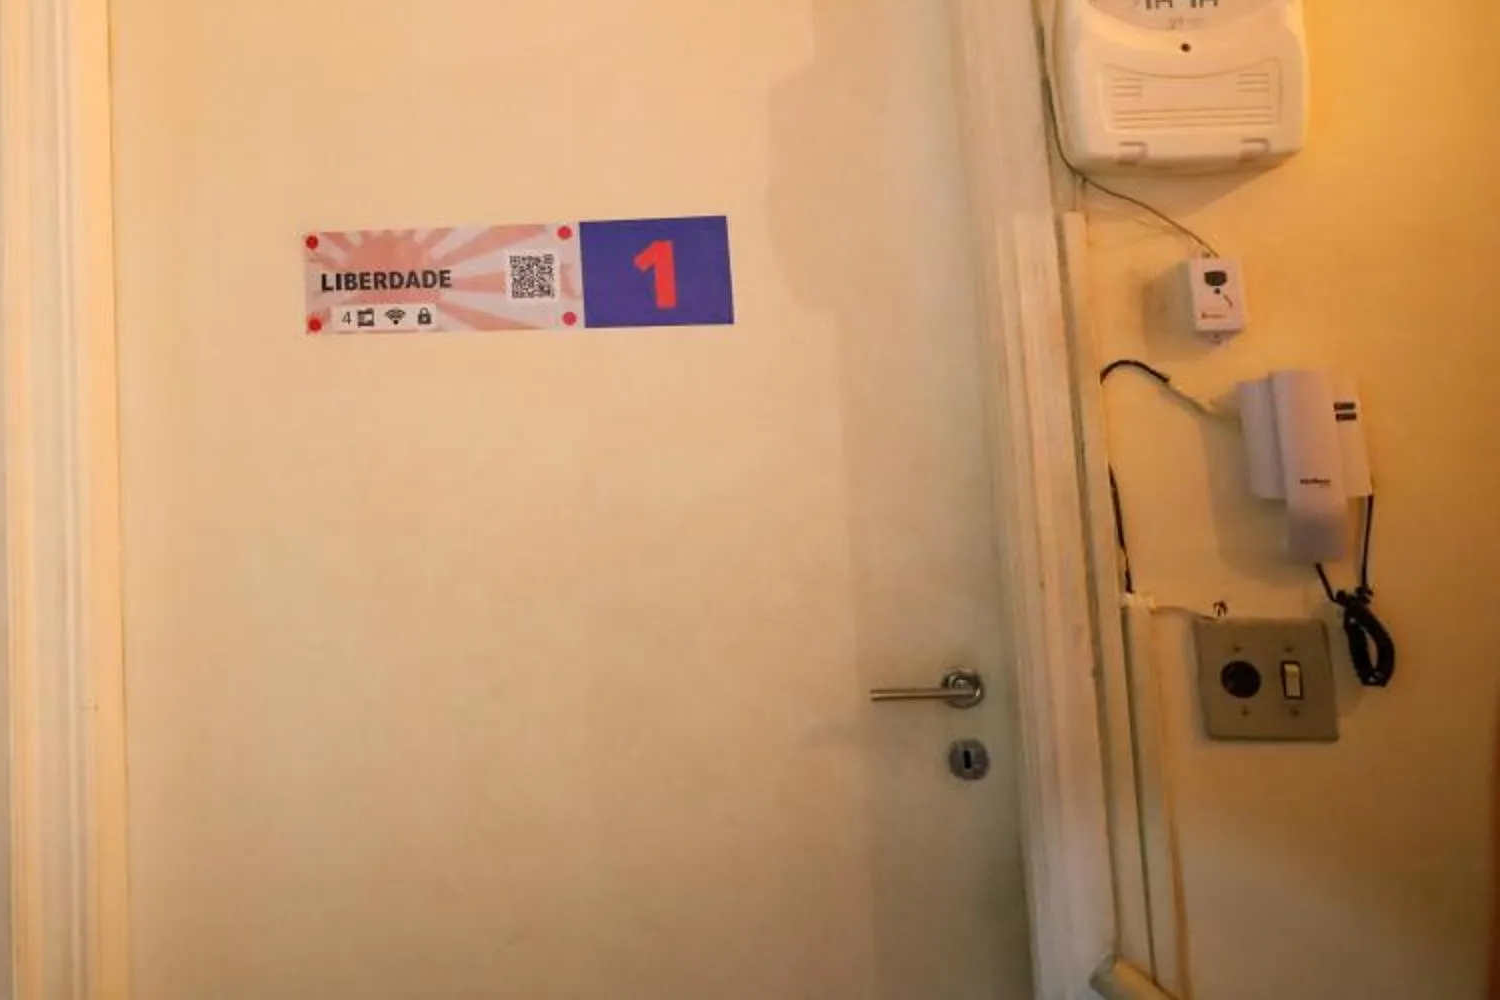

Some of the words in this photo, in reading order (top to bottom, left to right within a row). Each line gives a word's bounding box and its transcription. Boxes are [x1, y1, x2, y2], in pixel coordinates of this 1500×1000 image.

[320, 269, 453, 292] LIBERDADE
[633, 240, 678, 310] 1
[341, 311, 352, 325] 4
